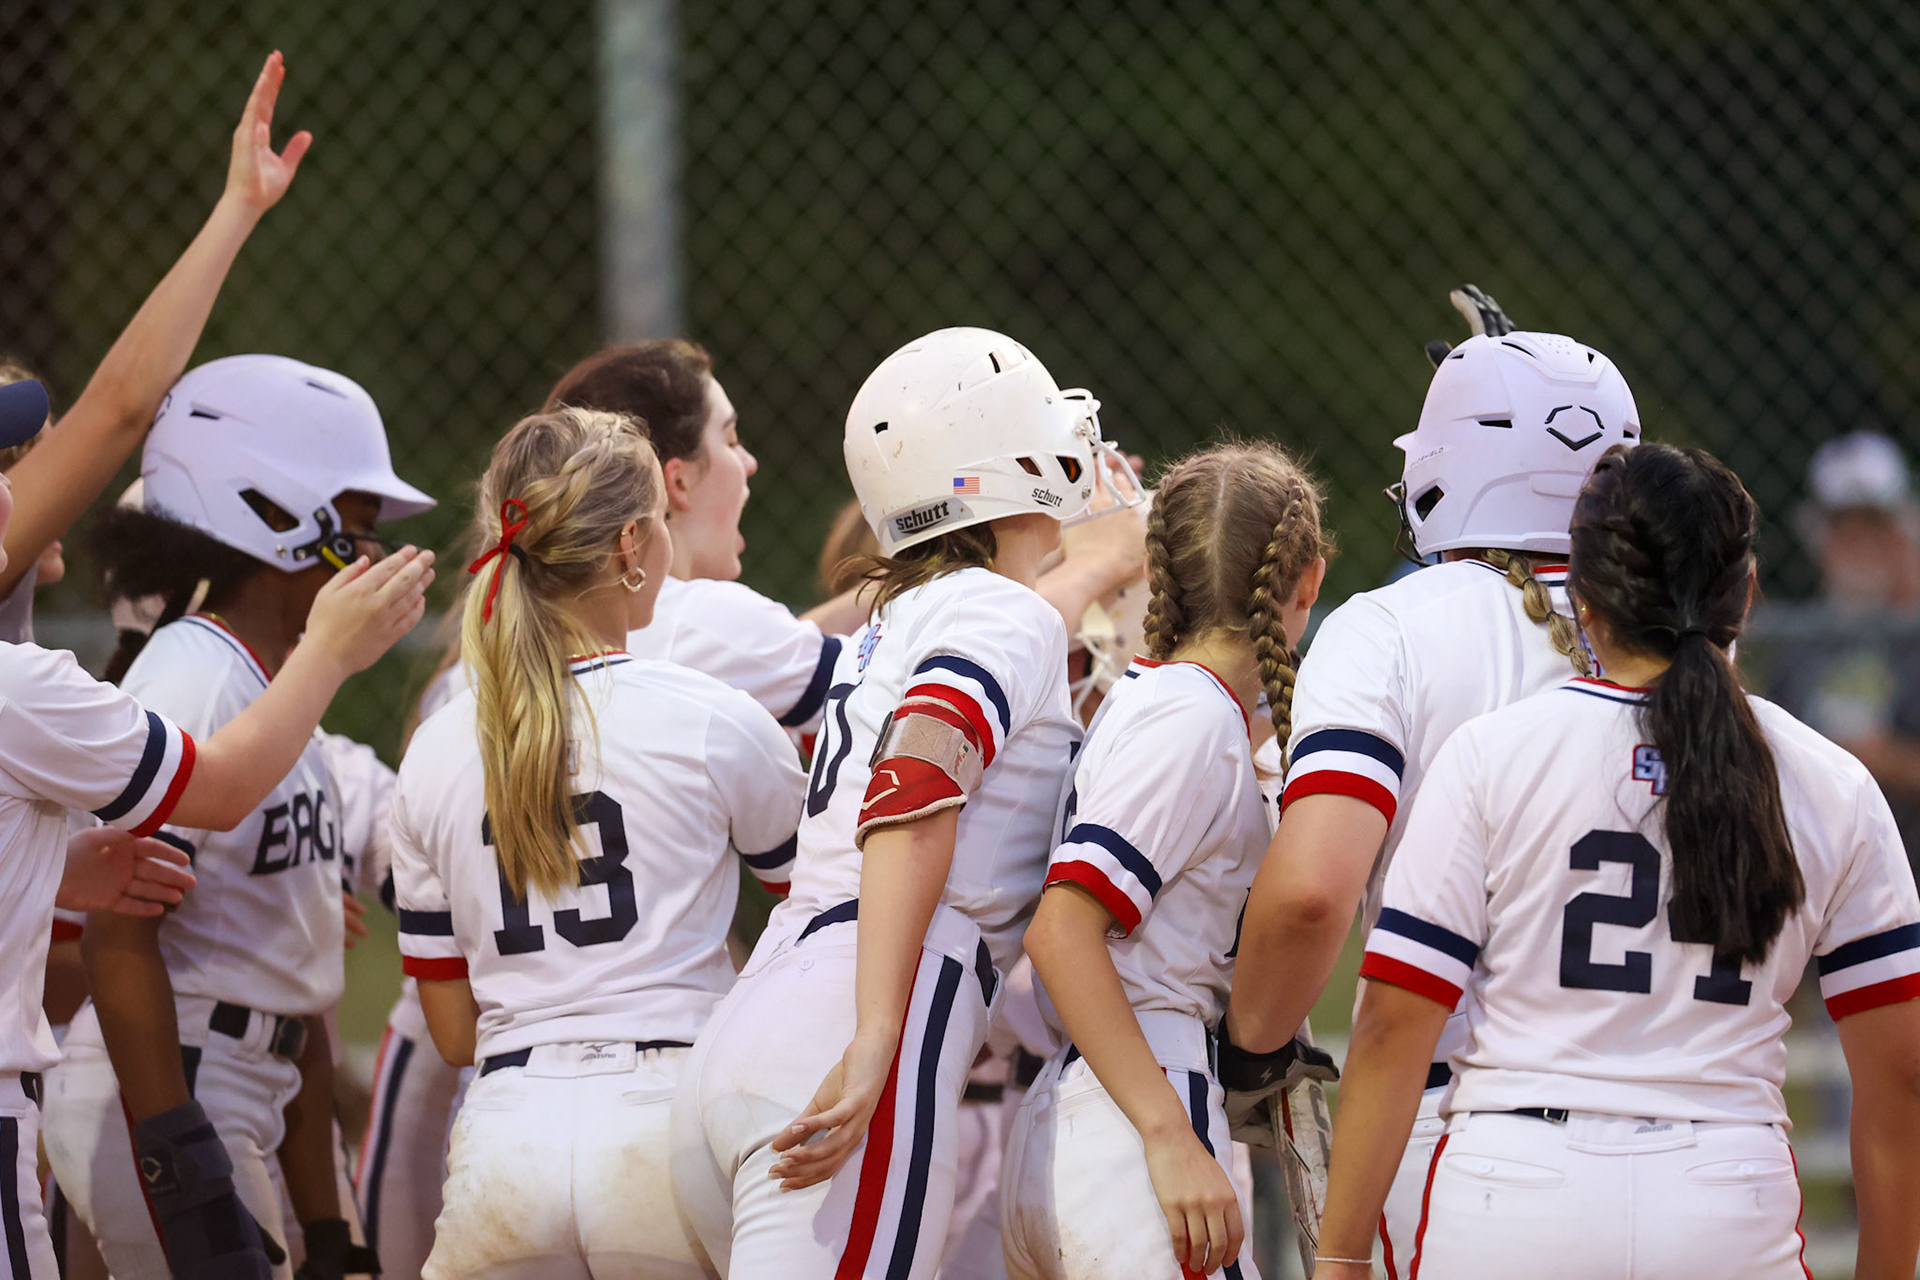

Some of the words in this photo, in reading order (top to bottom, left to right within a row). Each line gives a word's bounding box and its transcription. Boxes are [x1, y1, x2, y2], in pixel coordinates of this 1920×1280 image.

[1031, 487, 1063, 508] schutt
[895, 500, 950, 531] schutt
[482, 790, 639, 957] 13
